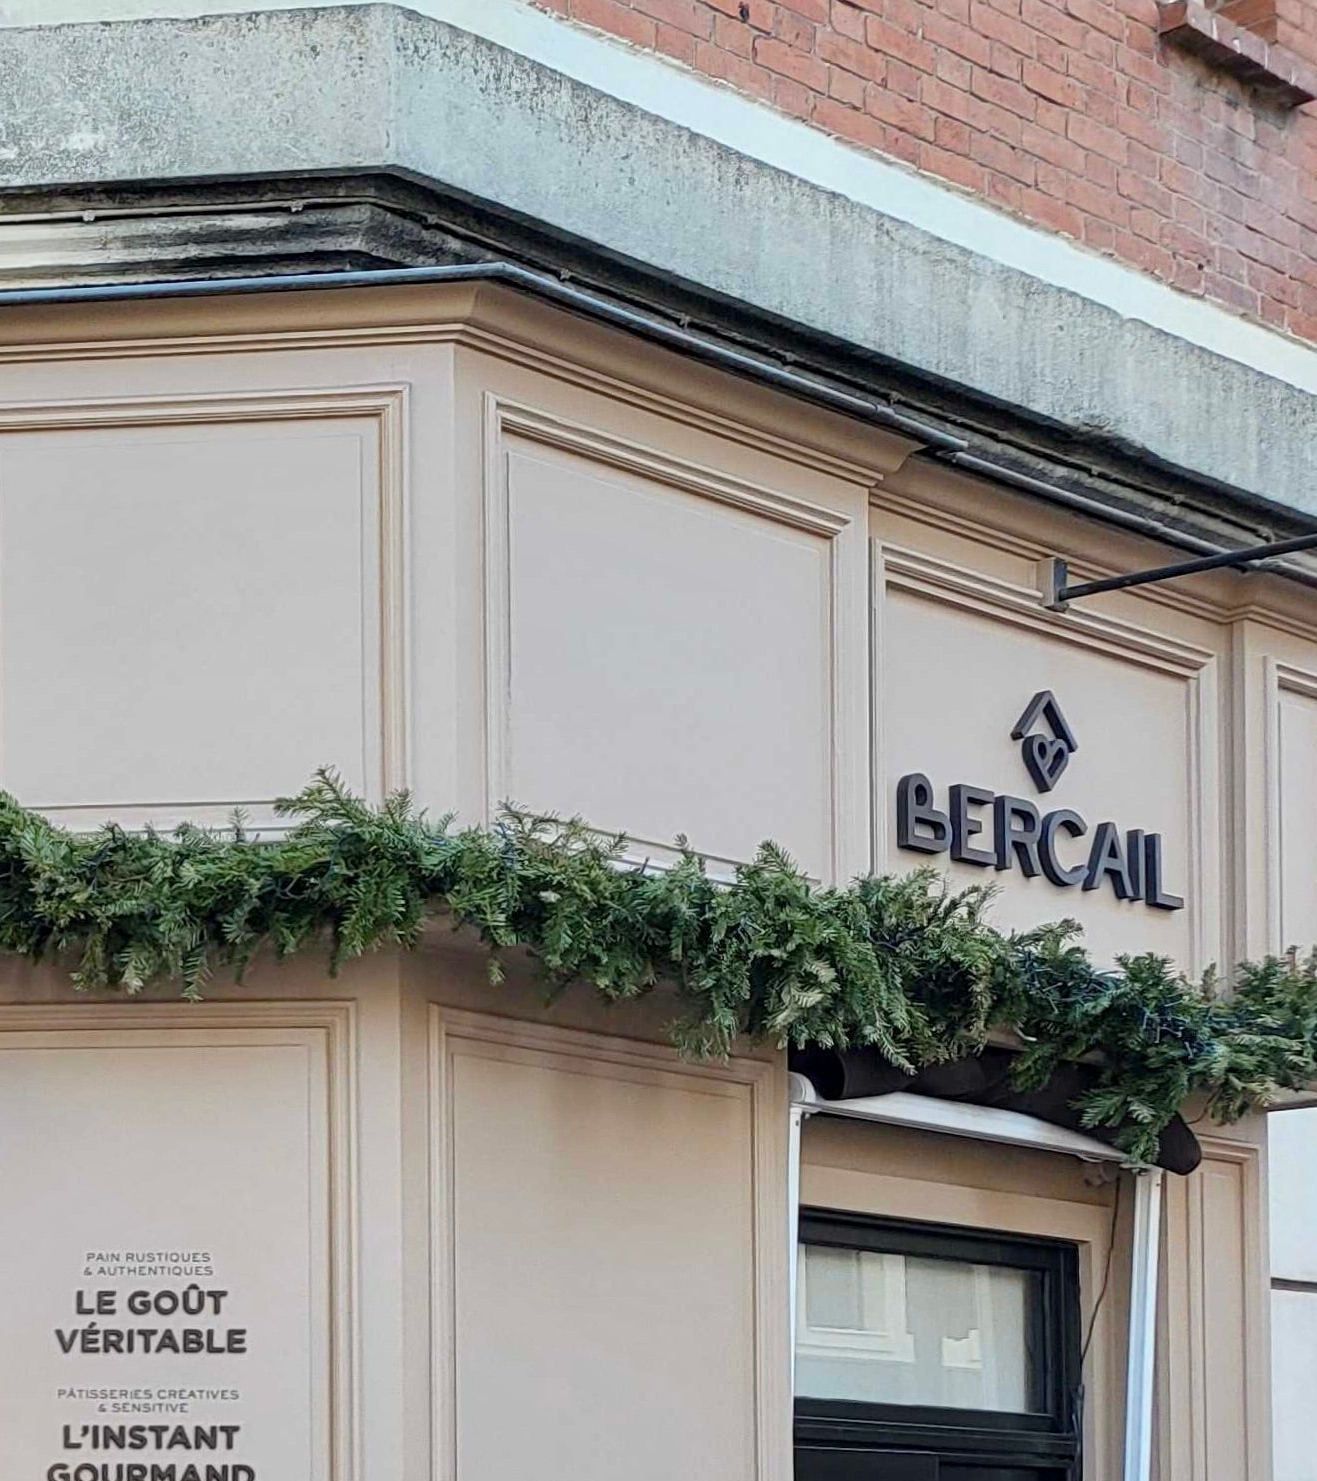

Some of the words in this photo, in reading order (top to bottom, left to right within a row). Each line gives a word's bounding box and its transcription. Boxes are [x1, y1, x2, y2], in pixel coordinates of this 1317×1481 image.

[896, 772, 1184, 910] BERCAIL
[86, 1252, 121, 1263] PAIN
[125, 1252, 211, 1263] RUSTIQUES
[83, 1266, 93, 1277] &
[96, 1266, 214, 1277] AUTHENTIQUES
[75, 1290, 117, 1315] LE
[127, 1283, 228, 1316] GOÛT
[54, 1321, 247, 1354] VÉRITABLE
[97, 1403, 107, 1413] &
[111, 1403, 189, 1413] SENSITIVE
